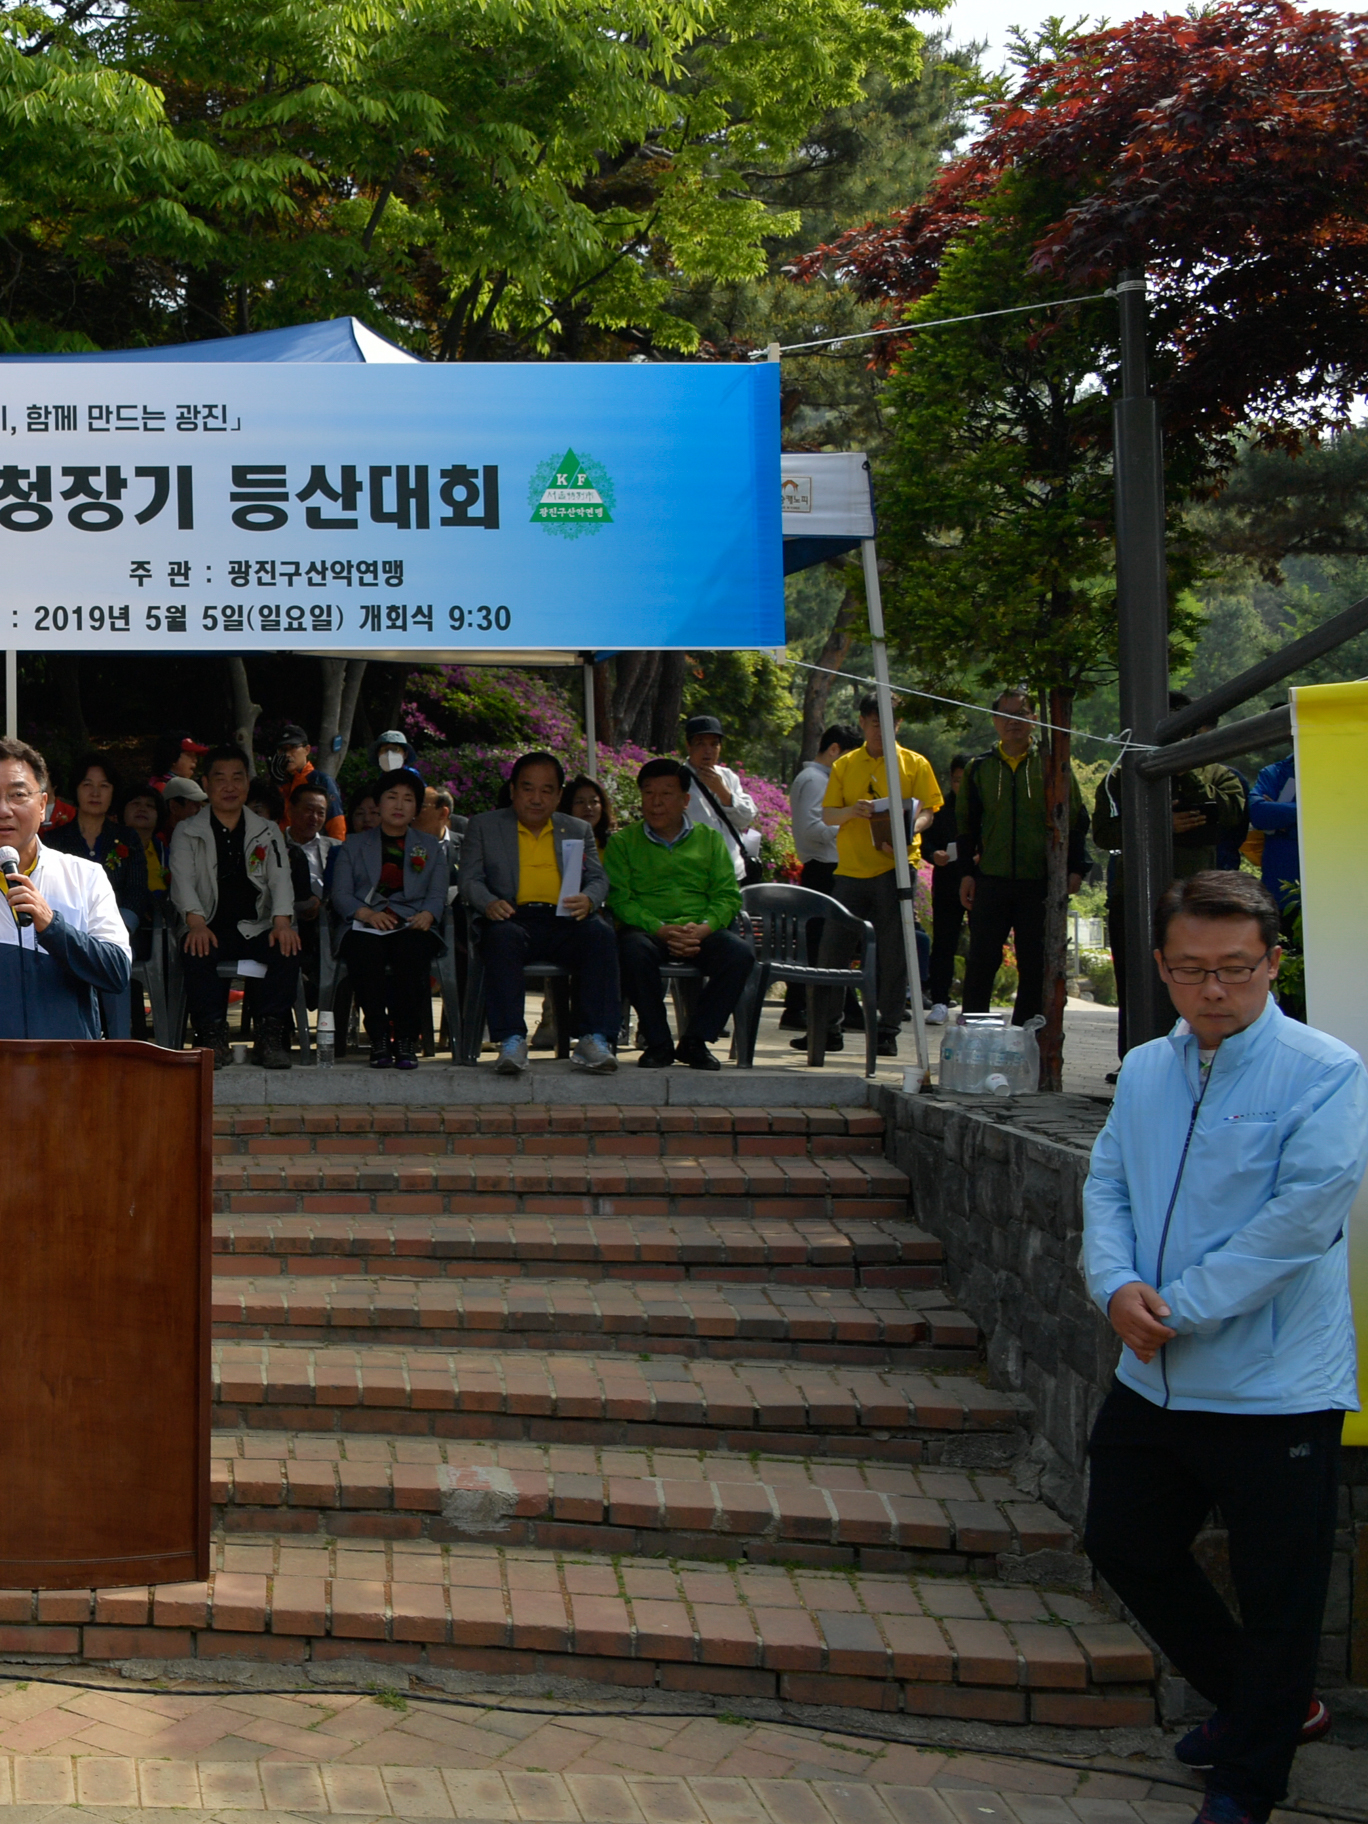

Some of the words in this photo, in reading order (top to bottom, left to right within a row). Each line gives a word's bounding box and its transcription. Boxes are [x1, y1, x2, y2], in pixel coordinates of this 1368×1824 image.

[26, 404, 78, 432] 함께
[88, 404, 167, 432] 만드는
[556, 473, 568, 485] K
[577, 473, 587, 485] F
[229, 464, 500, 532] 등산대회
[539, 507, 603, 517] 광진구산악연맹
[227, 559, 404, 588] 광진구산악연맹
[34, 605, 131, 632] 2019년
[145, 604, 187, 633] 5월
[202, 604, 344, 632] 5일(일요일)
[358, 604, 434, 632] 개회식
[448, 605, 512, 632] 9:30
